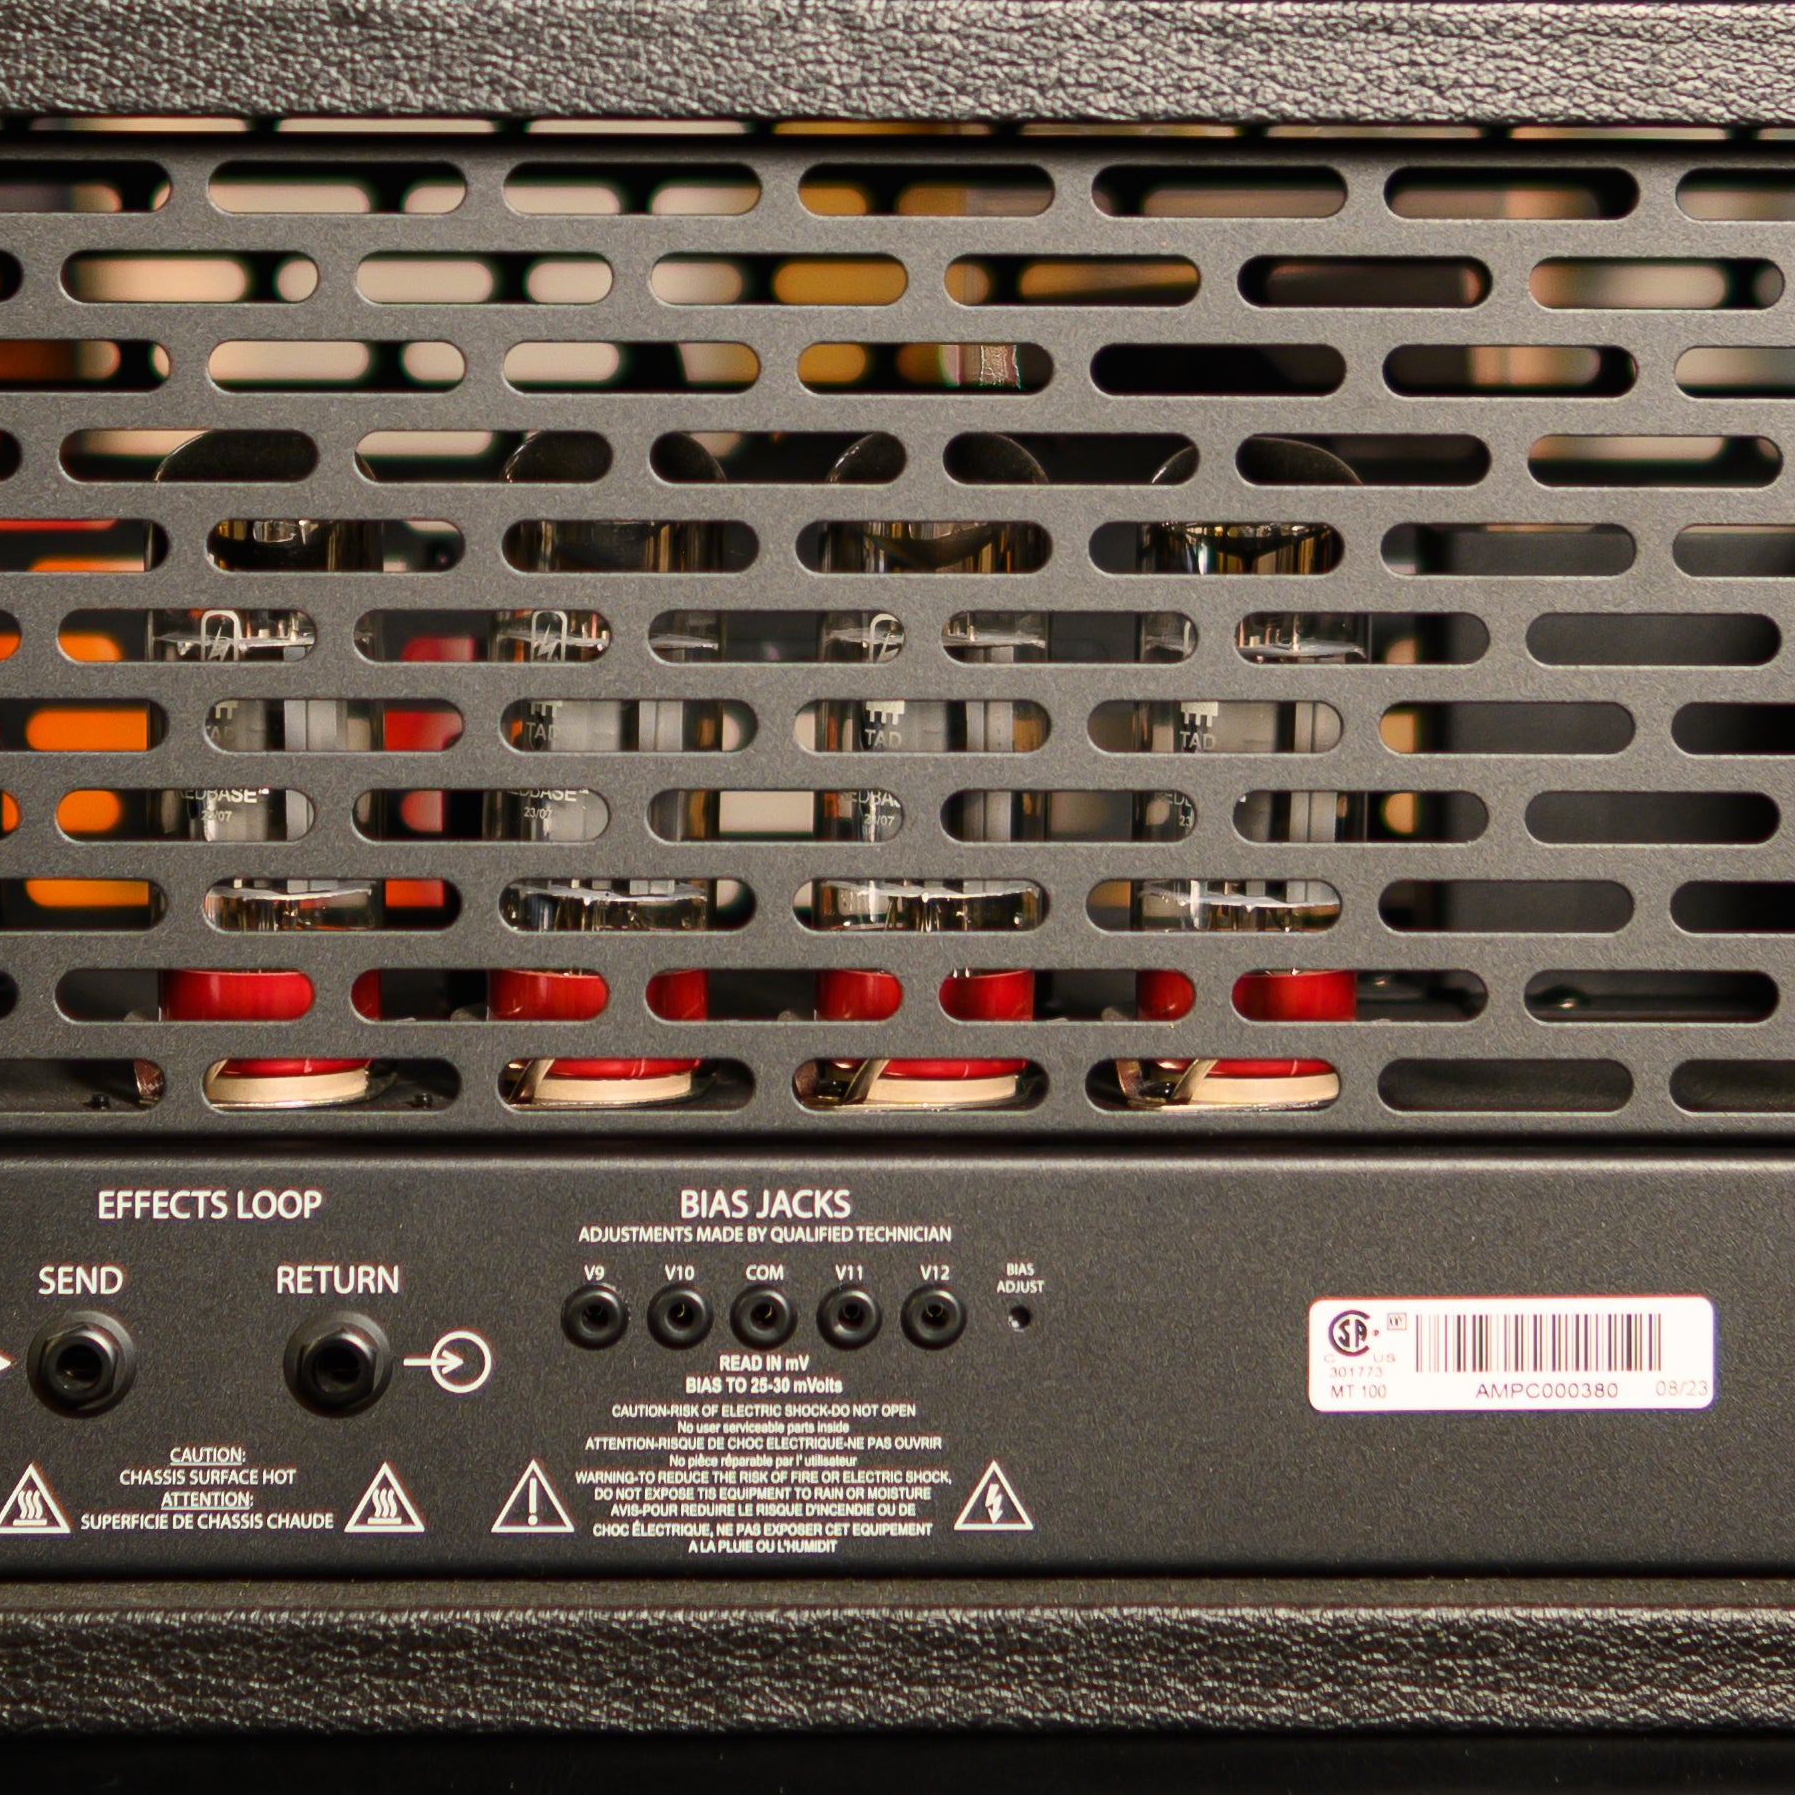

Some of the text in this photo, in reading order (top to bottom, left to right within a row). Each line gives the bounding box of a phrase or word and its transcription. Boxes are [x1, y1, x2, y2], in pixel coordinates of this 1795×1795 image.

[864, 728, 903, 749] TAD
[1179, 730, 1217, 751] TAD
[98, 1189, 323, 1220] EFFECTS LOOP
[680, 1189, 852, 1219] BIAS JACKS
[578, 1225, 952, 1244] ADJUSTMENTS MADE BY QUALIFIED TECHNICIAN
[583, 1264, 605, 1281] V9
[664, 1264, 695, 1281] V10
[745, 1263, 785, 1281] COM
[835, 1264, 863, 1281] V11
[920, 1264, 950, 1281] V12
[1006, 1262, 1035, 1277] BIAS
[38, 1265, 124, 1295] SEND
[277, 1264, 399, 1295] RETURN
[996, 1279, 1045, 1294] ADJUST
[719, 1354, 810, 1372] READ IN mV
[685, 1376, 844, 1394] BIAS TO 25-30 mVolts
[1331, 1384, 1387, 1398] MT 100
[1476, 1382, 1618, 1399] AMPC000380
[1655, 1380, 1708, 1397] 08/23
[701, 1403, 719, 1418] OF
[721, 1403, 782, 1418] ELECTRIC
[852, 1403, 879, 1418] NOT
[881, 1403, 917, 1418] OPEN
[707, 1436, 725, 1451] DE
[727, 1436, 764, 1451] CHOC
[867, 1435, 893, 1451] PAS
[894, 1435, 943, 1450] OUVRIR
[169, 1446, 246, 1467] CAUTION:
[119, 1468, 297, 1486] CHASSIS SURFACE HOT
[160, 1490, 254, 1511] ATTENTION:
[80, 1512, 334, 1530] SUPERFICIE DE CHASSIS CHAUDE
